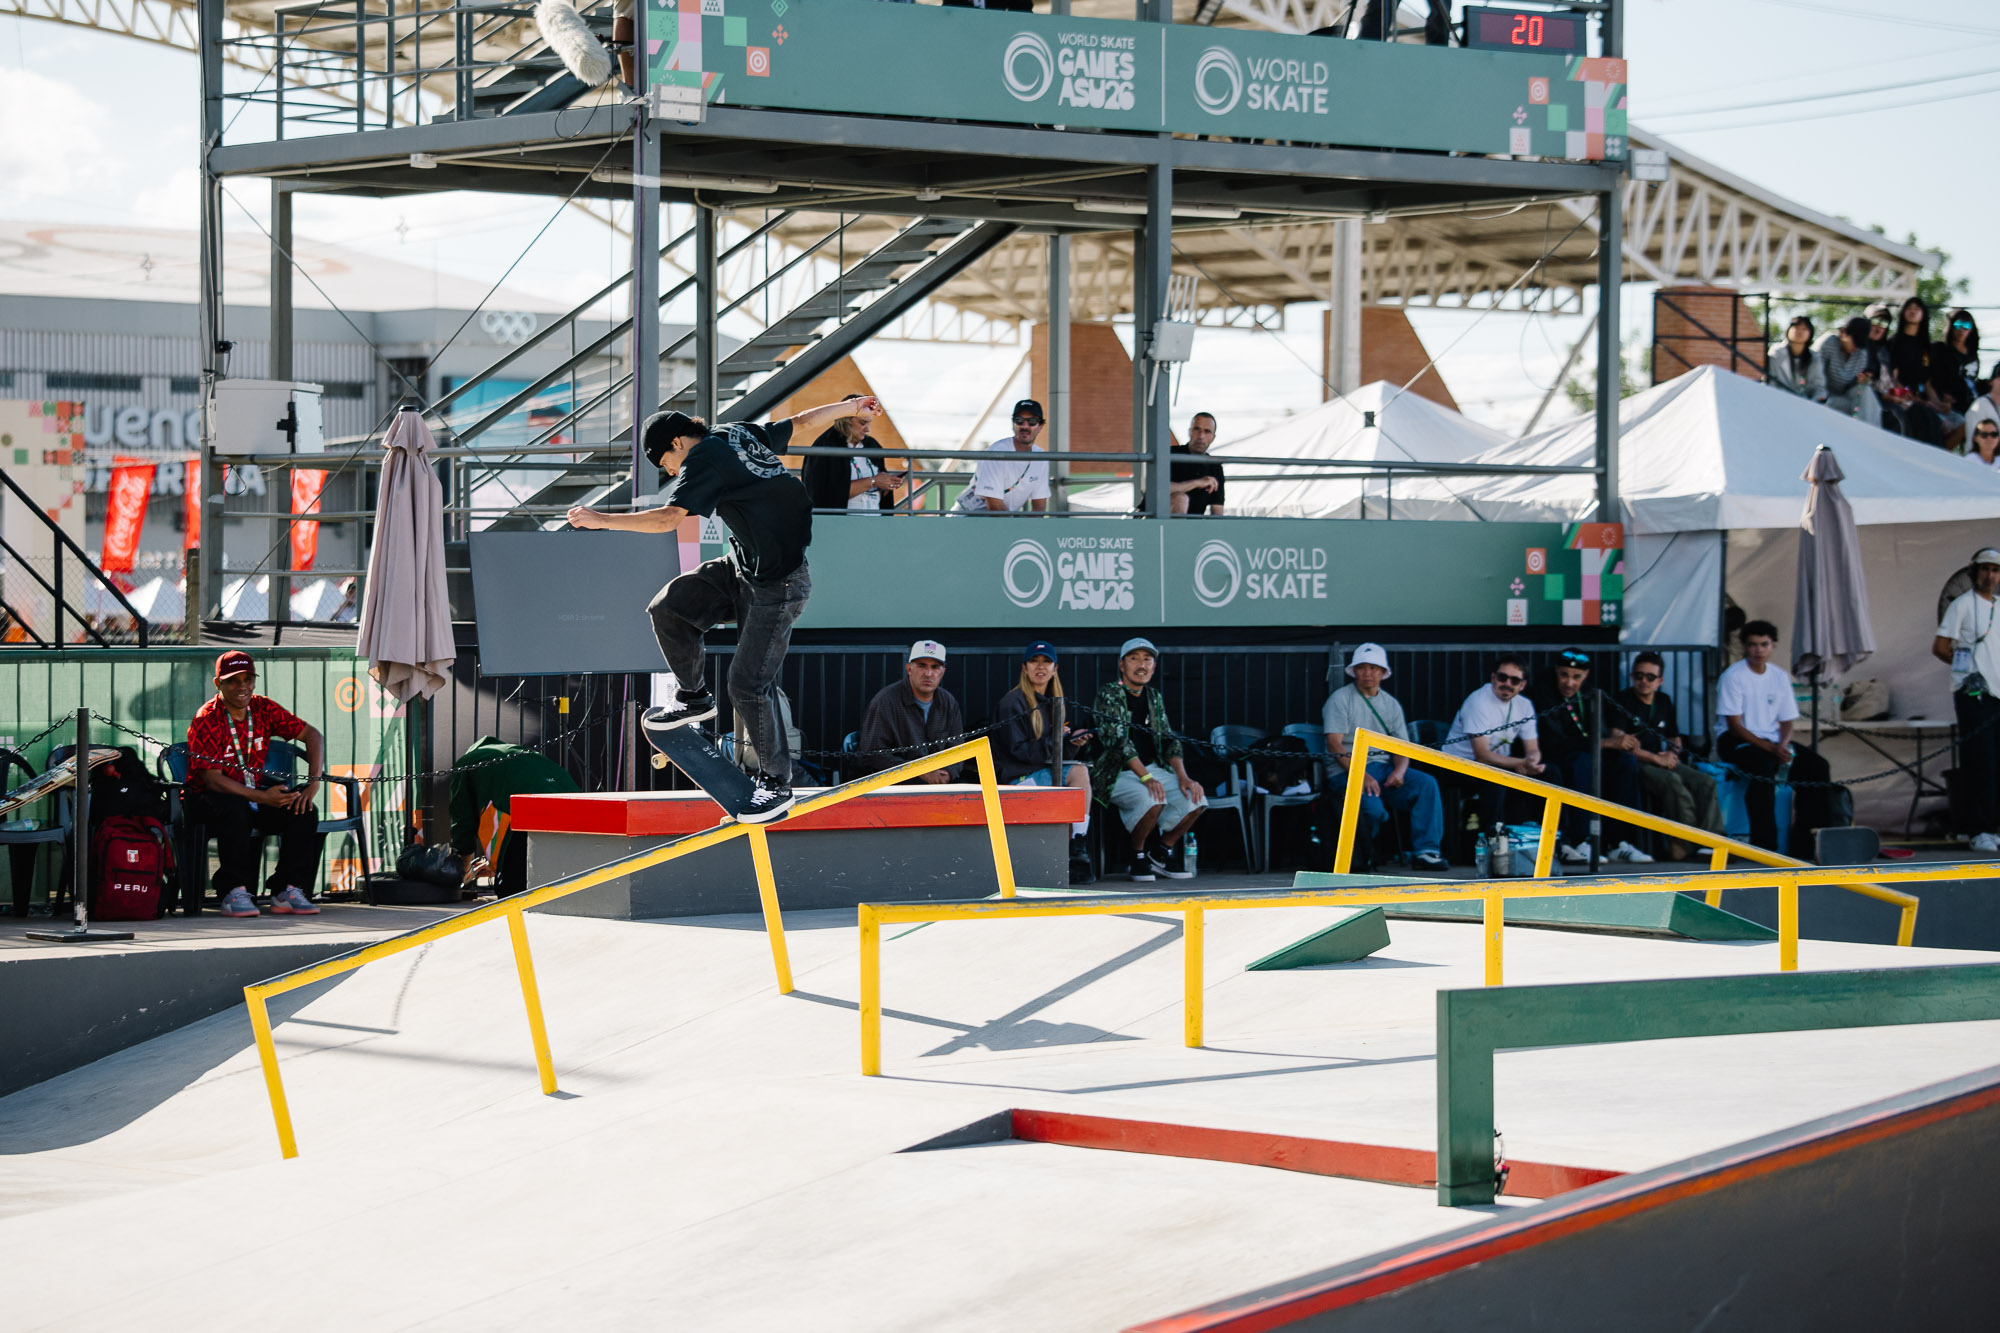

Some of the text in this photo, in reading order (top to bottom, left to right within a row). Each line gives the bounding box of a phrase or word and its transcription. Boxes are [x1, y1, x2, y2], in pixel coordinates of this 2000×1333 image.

[1058, 32, 1136, 50] WORLD SKATE
[1511, 14, 1544, 46] 20
[1058, 48, 1135, 80] GAMES
[1247, 56, 1329, 86] WORLD
[1058, 79, 1136, 111] ASU26
[1247, 84, 1329, 114] SKATE
[1057, 537, 1134, 550] WORLD SKATE
[1057, 552, 1134, 581] GAMES
[1246, 547, 1327, 571] WORLD
[1058, 580, 1135, 611] ASU26
[1246, 572, 1328, 599] SKATE
[114, 883, 148, 893] PERU
